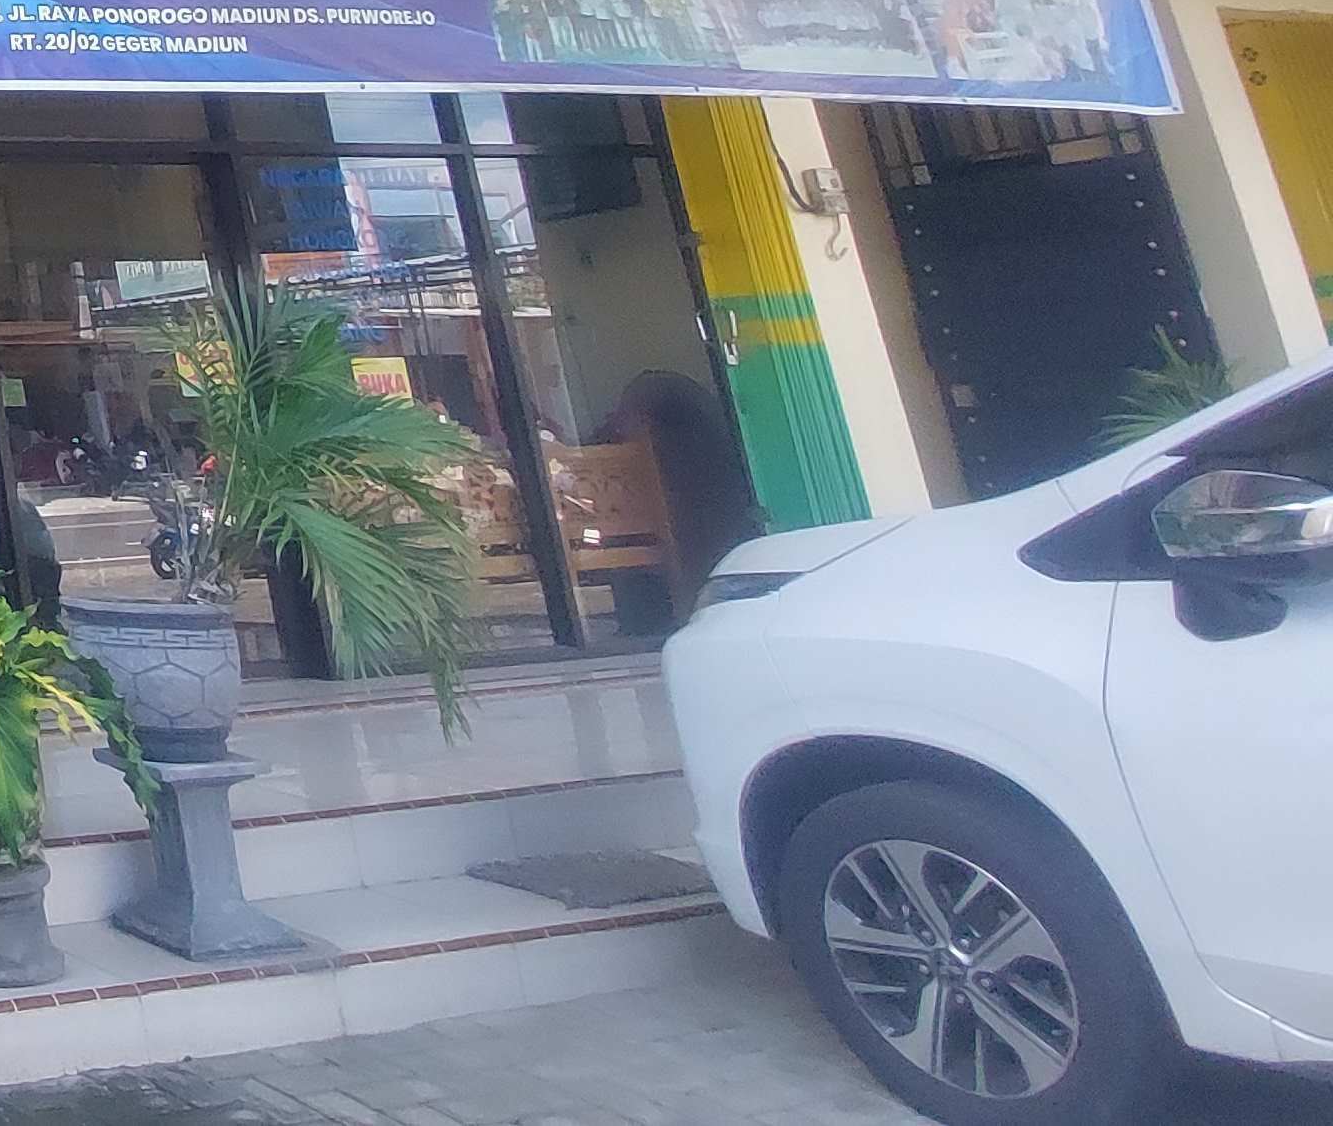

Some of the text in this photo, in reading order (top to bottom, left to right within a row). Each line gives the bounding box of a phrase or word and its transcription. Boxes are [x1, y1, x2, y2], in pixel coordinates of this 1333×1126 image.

[7, 4, 436, 27] JL. RAYA PONOROGO MADIUN DS. PURWOREJO
[10, 29, 248, 54] RT. 20/02 GEGER MADIUN
